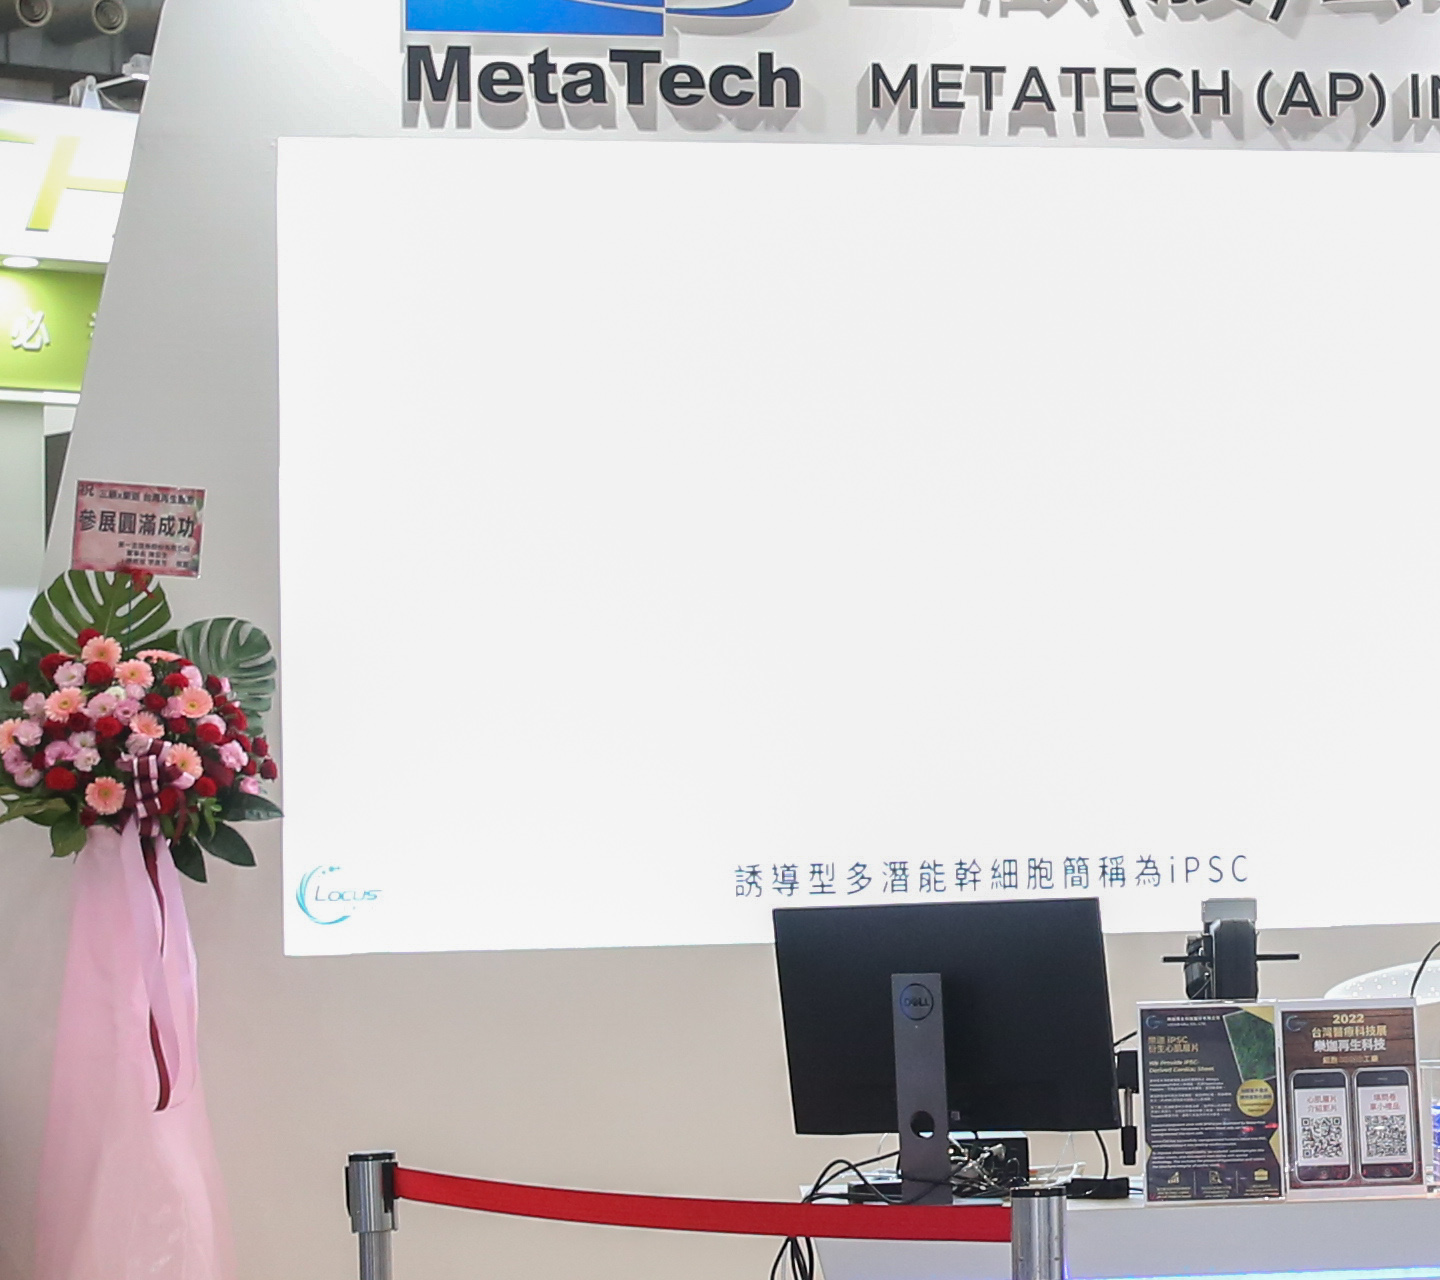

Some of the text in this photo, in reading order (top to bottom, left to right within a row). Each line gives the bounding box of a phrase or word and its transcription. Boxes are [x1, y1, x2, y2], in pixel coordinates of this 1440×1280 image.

[404, 44, 802, 110] MetaTech
[871, 62, 1230, 113] METATECH
[1256, 67, 1387, 130] (AP)
[1332, 1013, 1365, 1024] 2022
